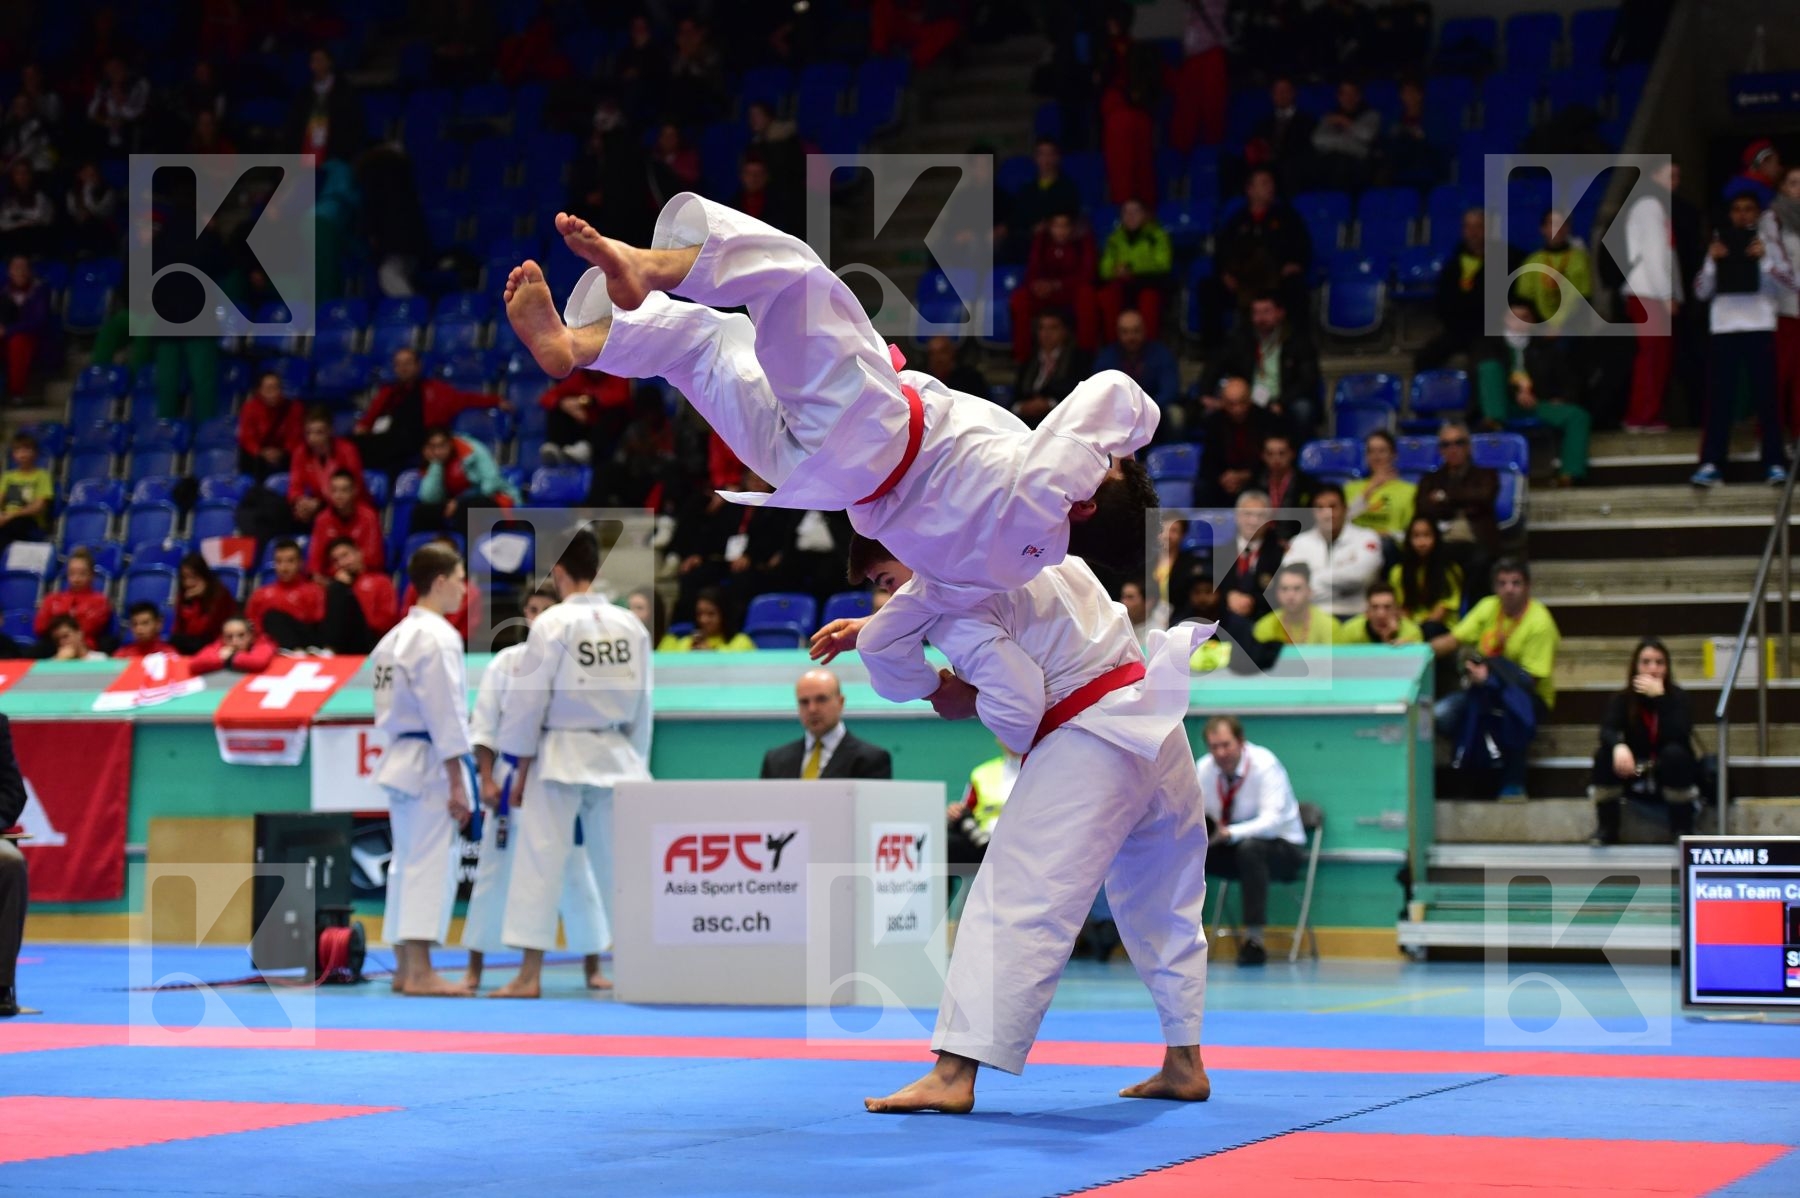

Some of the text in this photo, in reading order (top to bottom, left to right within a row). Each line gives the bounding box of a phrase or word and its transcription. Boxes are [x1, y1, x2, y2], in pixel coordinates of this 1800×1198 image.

[578, 638, 631, 667] SRB
[664, 834, 763, 873] ASC
[875, 834, 914, 873] ASC
[1689, 848, 1769, 864] TATAMI 5
[664, 880, 798, 897] Asia Sport Center
[1695, 883, 1733, 899] Kata
[1737, 883, 1781, 899] Team
[692, 911, 770, 932] asc.ch
